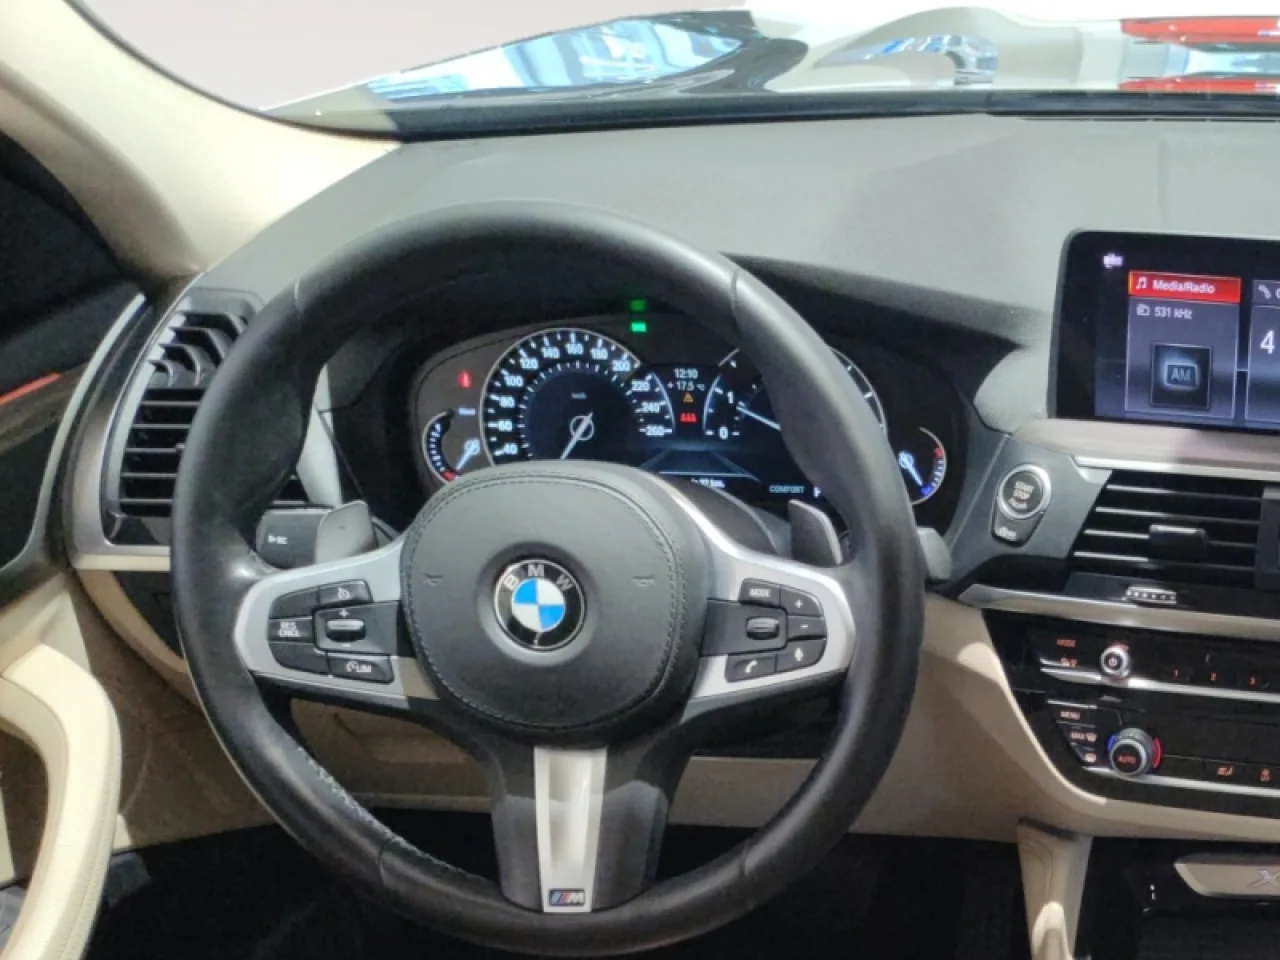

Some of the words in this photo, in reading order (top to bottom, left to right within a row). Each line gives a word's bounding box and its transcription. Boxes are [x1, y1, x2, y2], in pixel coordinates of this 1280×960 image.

[1153, 279, 1216, 295] Media/Radio
[1154, 306, 1171, 319] 531
[1174, 308, 1192, 320] kHz
[1260, 330, 1275, 355] 4
[542, 346, 560, 359] 140
[566, 343, 583, 356] 160
[591, 348, 608, 361] 180
[520, 357, 538, 370] 120
[613, 360, 630, 372] 200
[675, 368, 698, 379] 12:10
[1170, 367, 1192, 382] AM
[505, 375, 523, 387] 100
[632, 380, 650, 391] 220
[500, 396, 515, 408] 80
[642, 401, 660, 413] 240
[718, 426, 729, 440] 0
[504, 442, 518, 455] 40
[503, 563, 574, 592] BMW
